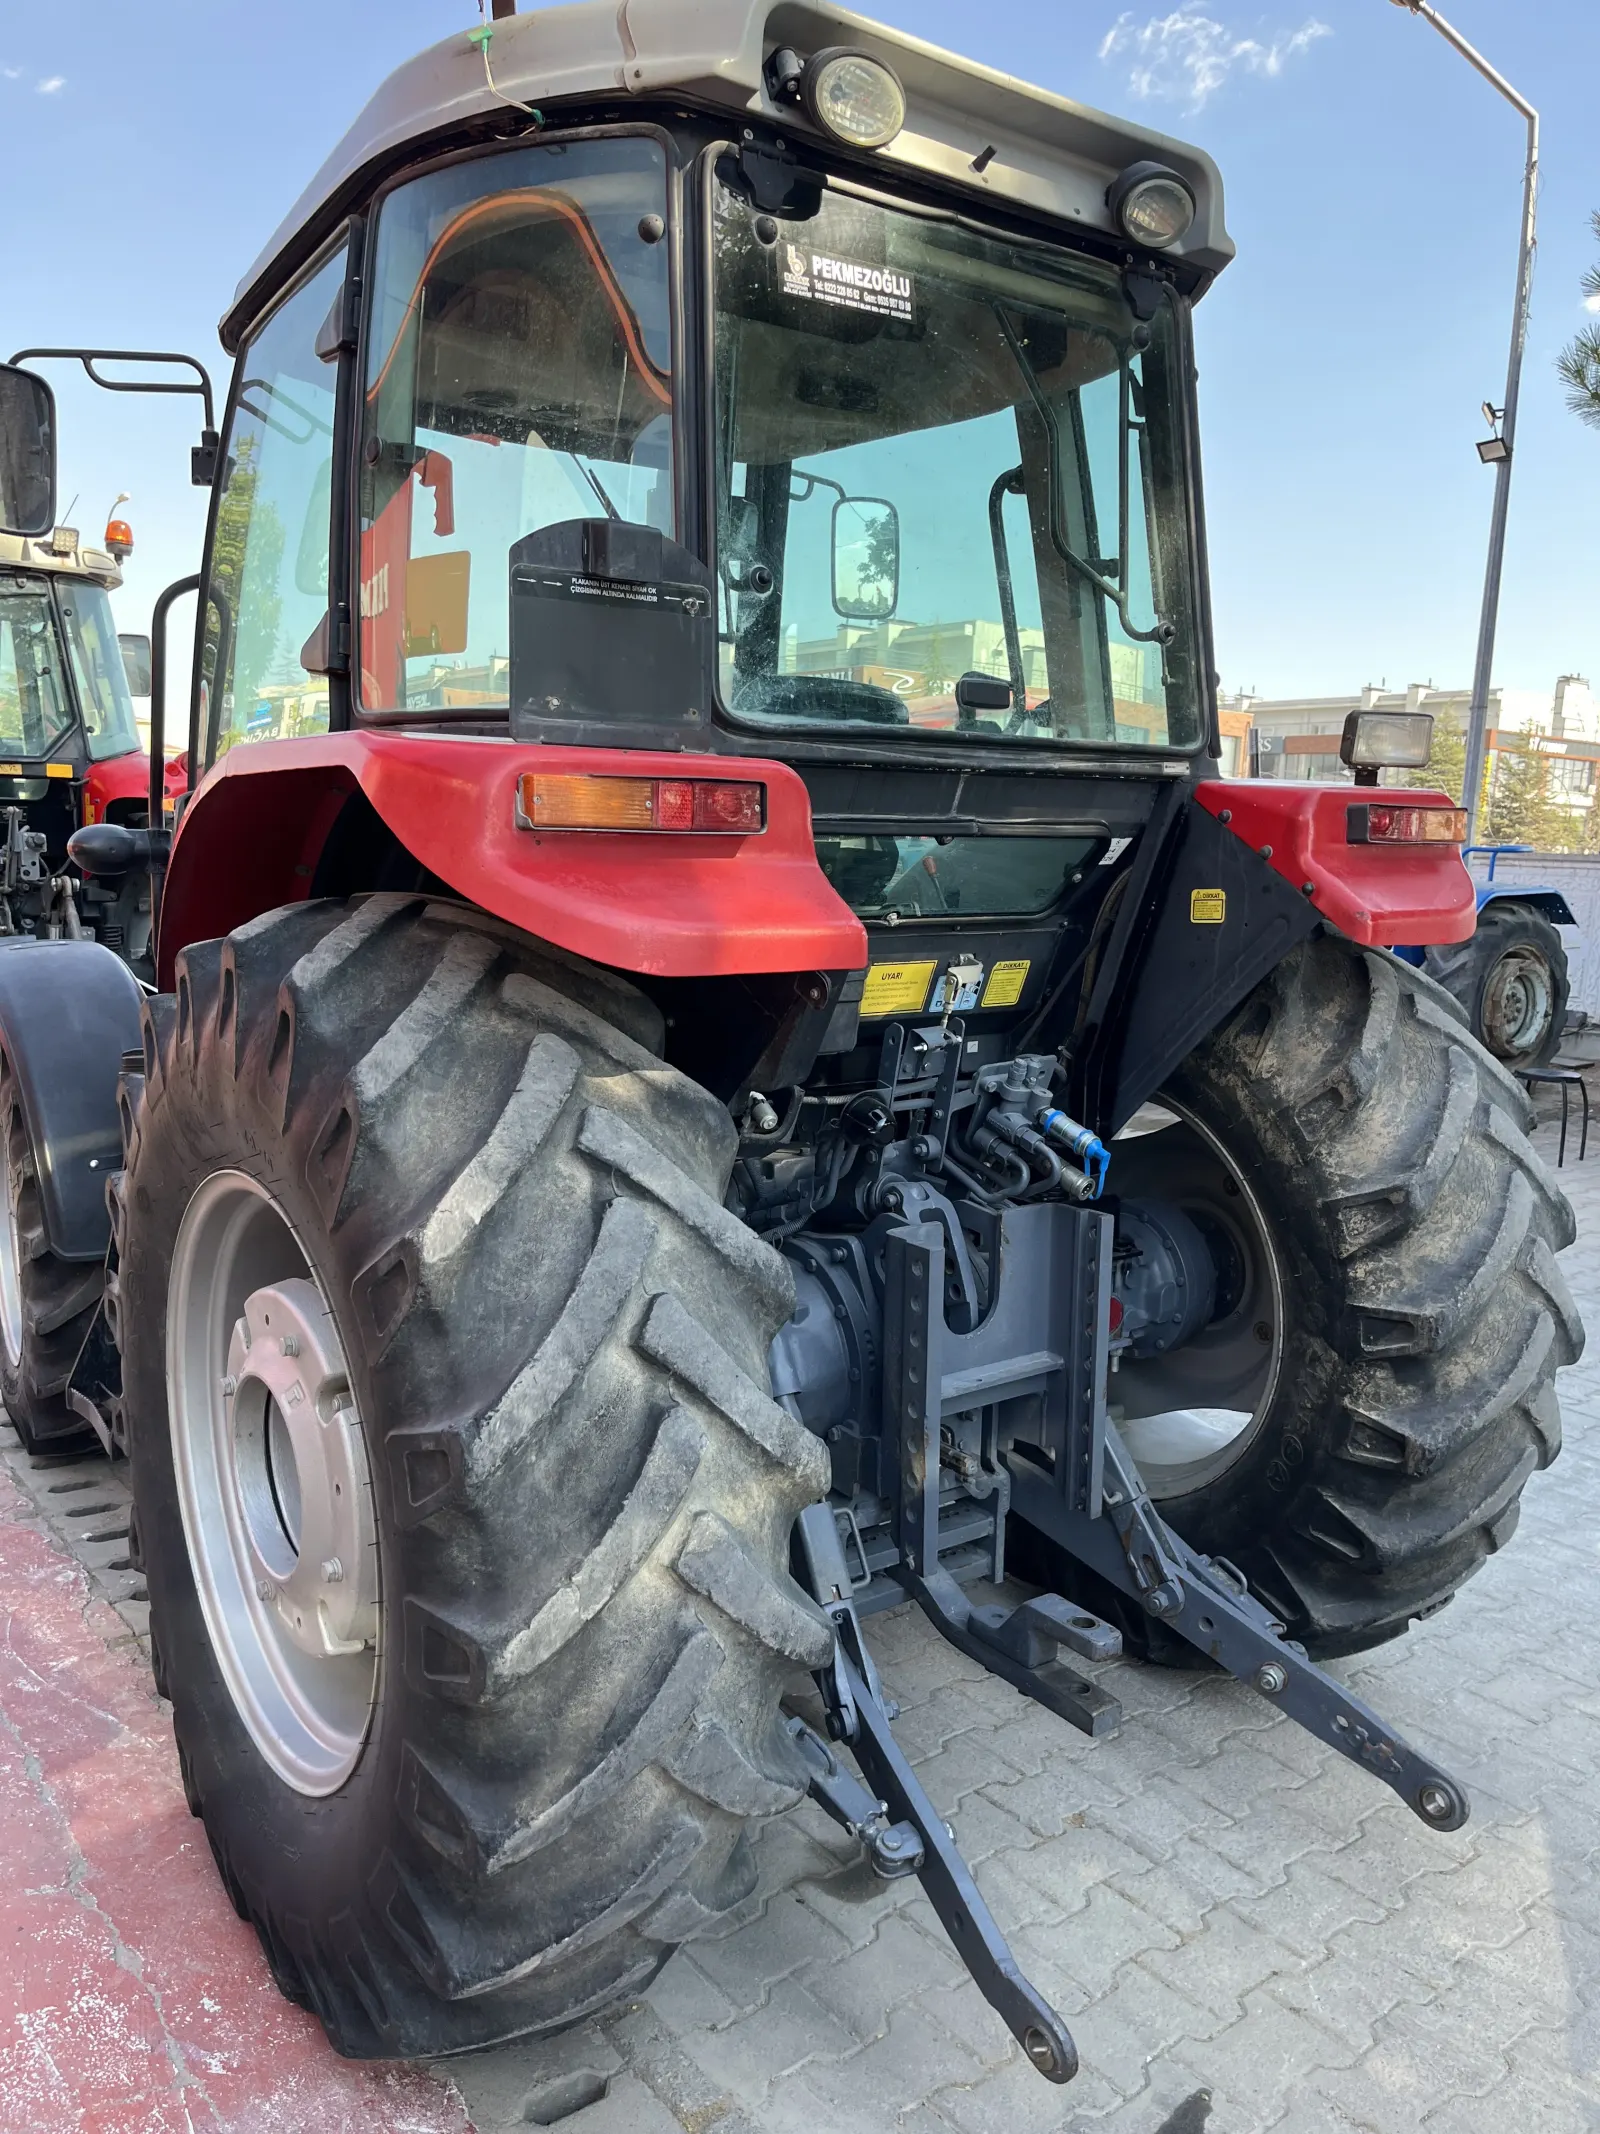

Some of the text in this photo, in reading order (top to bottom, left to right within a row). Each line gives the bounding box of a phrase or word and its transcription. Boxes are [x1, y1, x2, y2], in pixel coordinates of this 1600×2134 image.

[812, 255, 911, 298] PEKMEZOĞLU
[571, 577, 600, 587] PLAKANIN
[600, 579, 611, 588] ÜST
[648, 587, 657, 595] OK
[602, 589, 626, 599] ALTINDA
[626, 592, 658, 602] KALMALIDIR
[881, 972, 904, 981] UYARI
